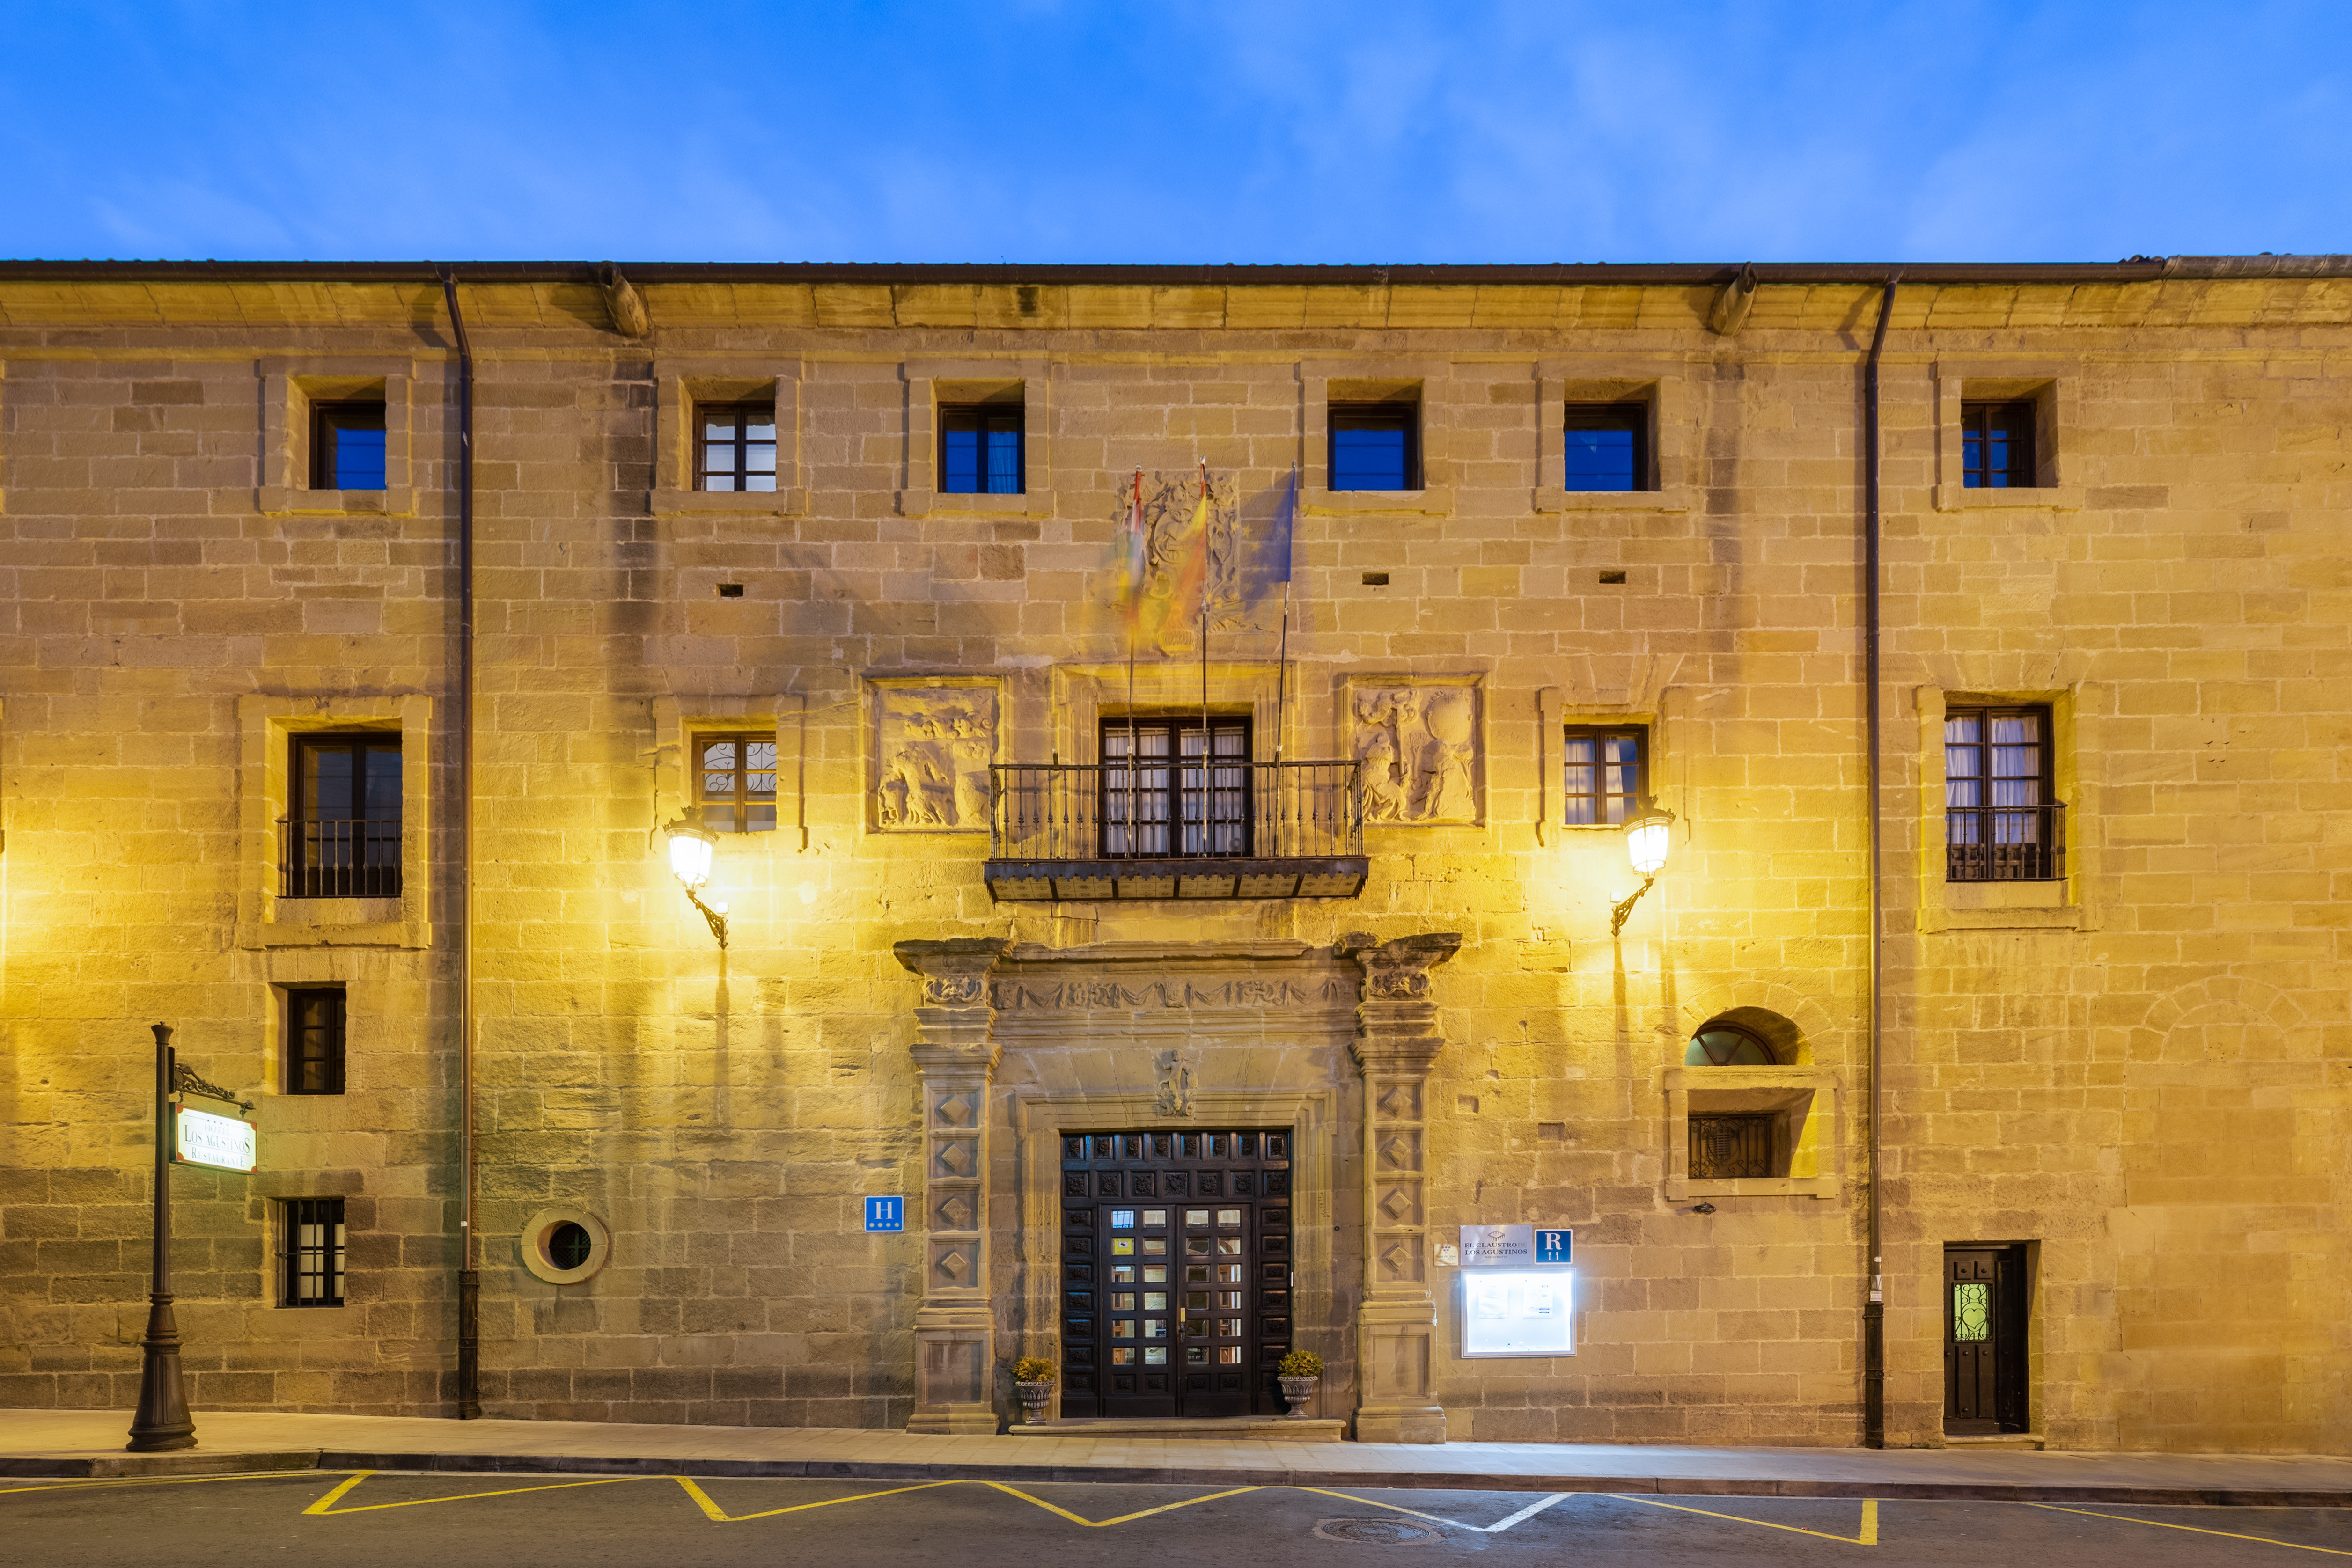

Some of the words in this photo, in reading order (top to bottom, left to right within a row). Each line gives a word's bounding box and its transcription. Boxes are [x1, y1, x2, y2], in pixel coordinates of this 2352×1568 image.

[205, 1123, 231, 1136] HOTEL
[207, 1134, 250, 1153] AGUSTINOS
[192, 1147, 244, 1167] RESTAURANTE
[874, 1201, 894, 1219] H
[1544, 1233, 1562, 1250] R
